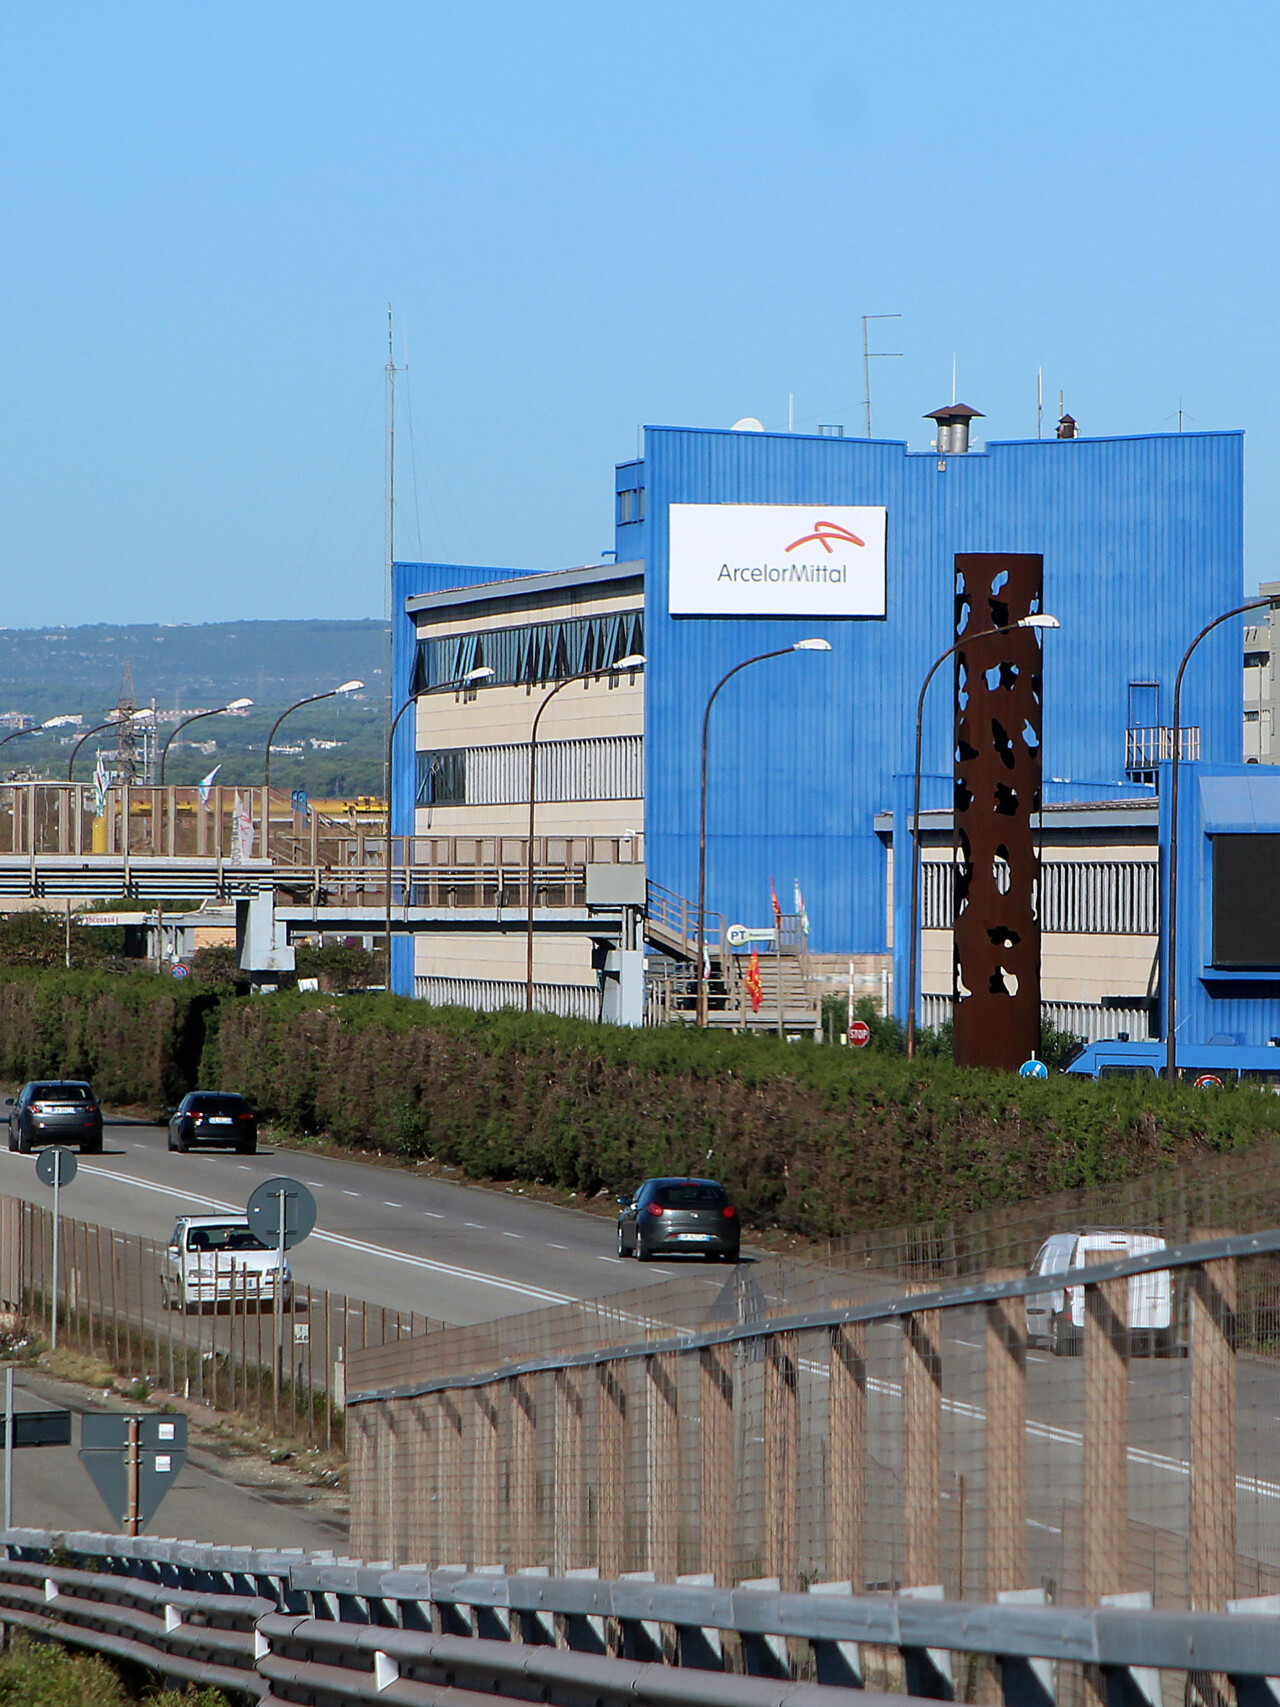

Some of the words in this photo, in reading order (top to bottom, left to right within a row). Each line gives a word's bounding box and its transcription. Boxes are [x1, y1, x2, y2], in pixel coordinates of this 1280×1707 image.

[717, 563, 847, 583] ArcelorMittal
[731, 931, 746, 940] PT
[850, 1029, 867, 1039] STOP
